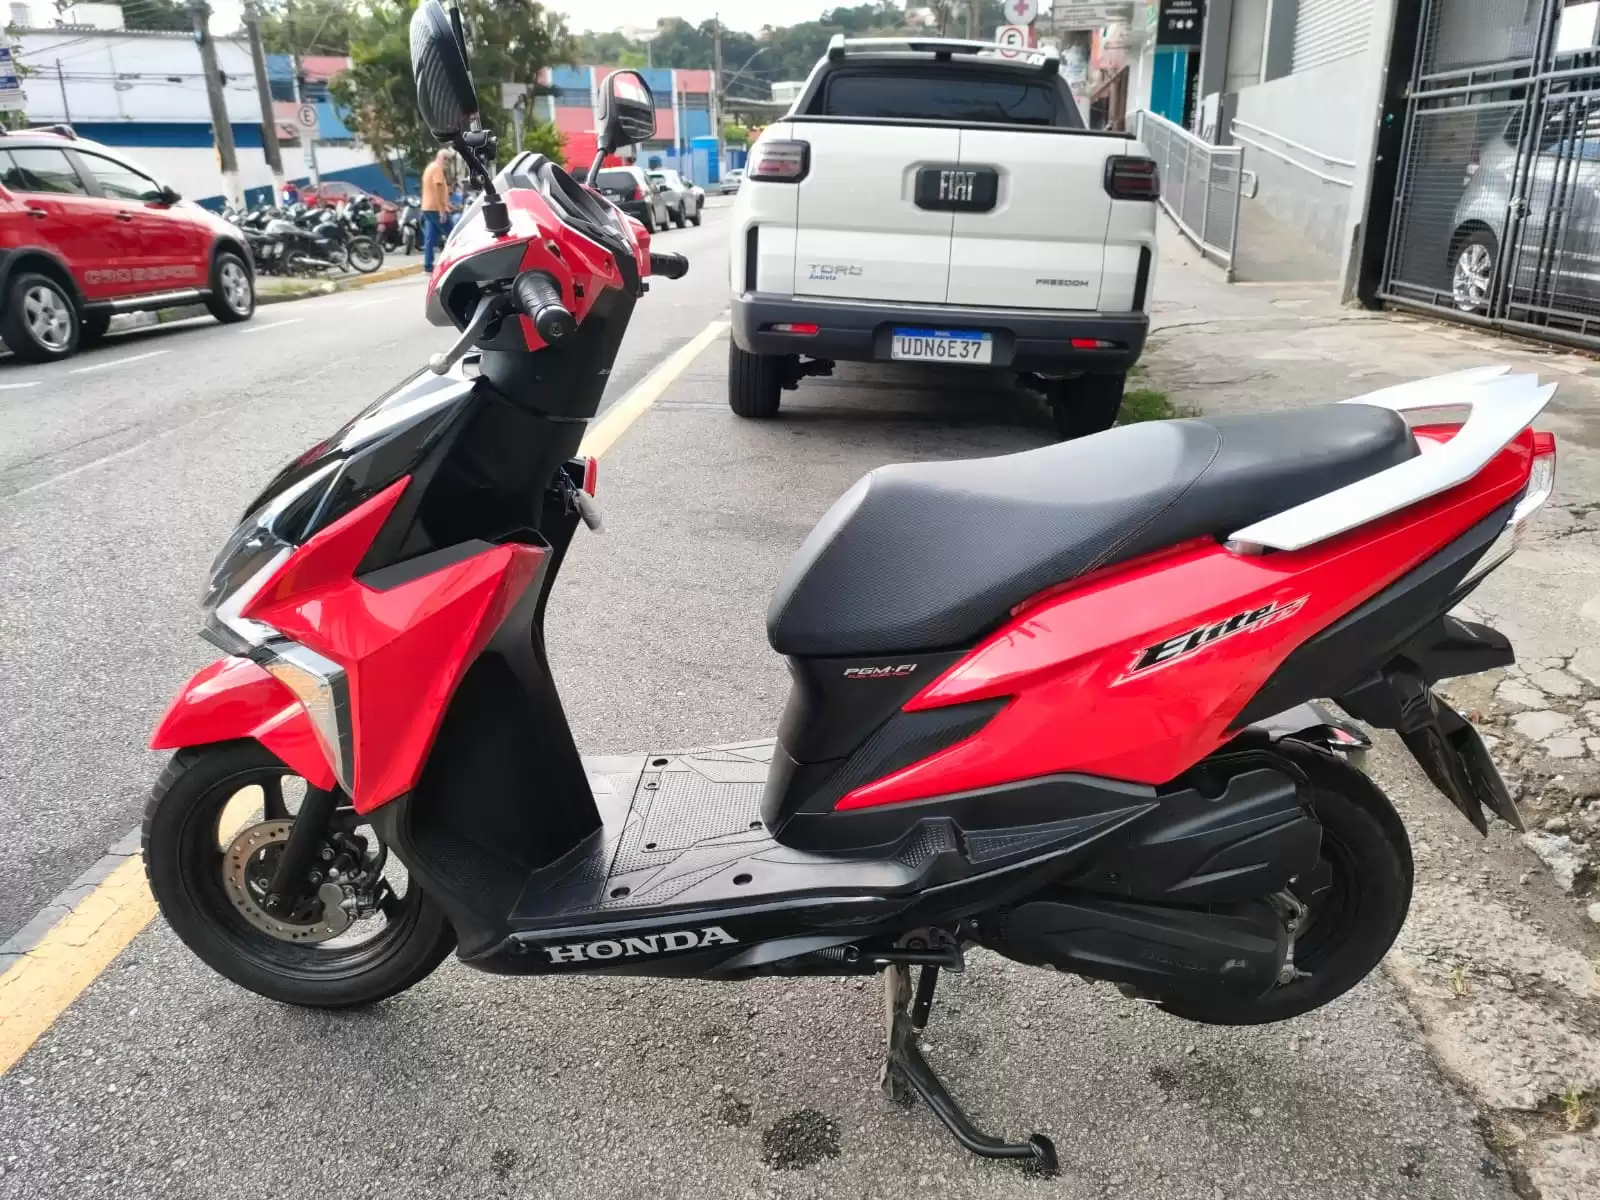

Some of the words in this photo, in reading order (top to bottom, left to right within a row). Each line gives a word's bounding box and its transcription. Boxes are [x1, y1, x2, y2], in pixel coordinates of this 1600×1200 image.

[939, 168, 977, 201] FIAT
[808, 263, 864, 276] TORO
[1035, 278, 1089, 288] FREEDOM
[901, 337, 982, 359] UDN6E37
[544, 926, 740, 964] HONDA
